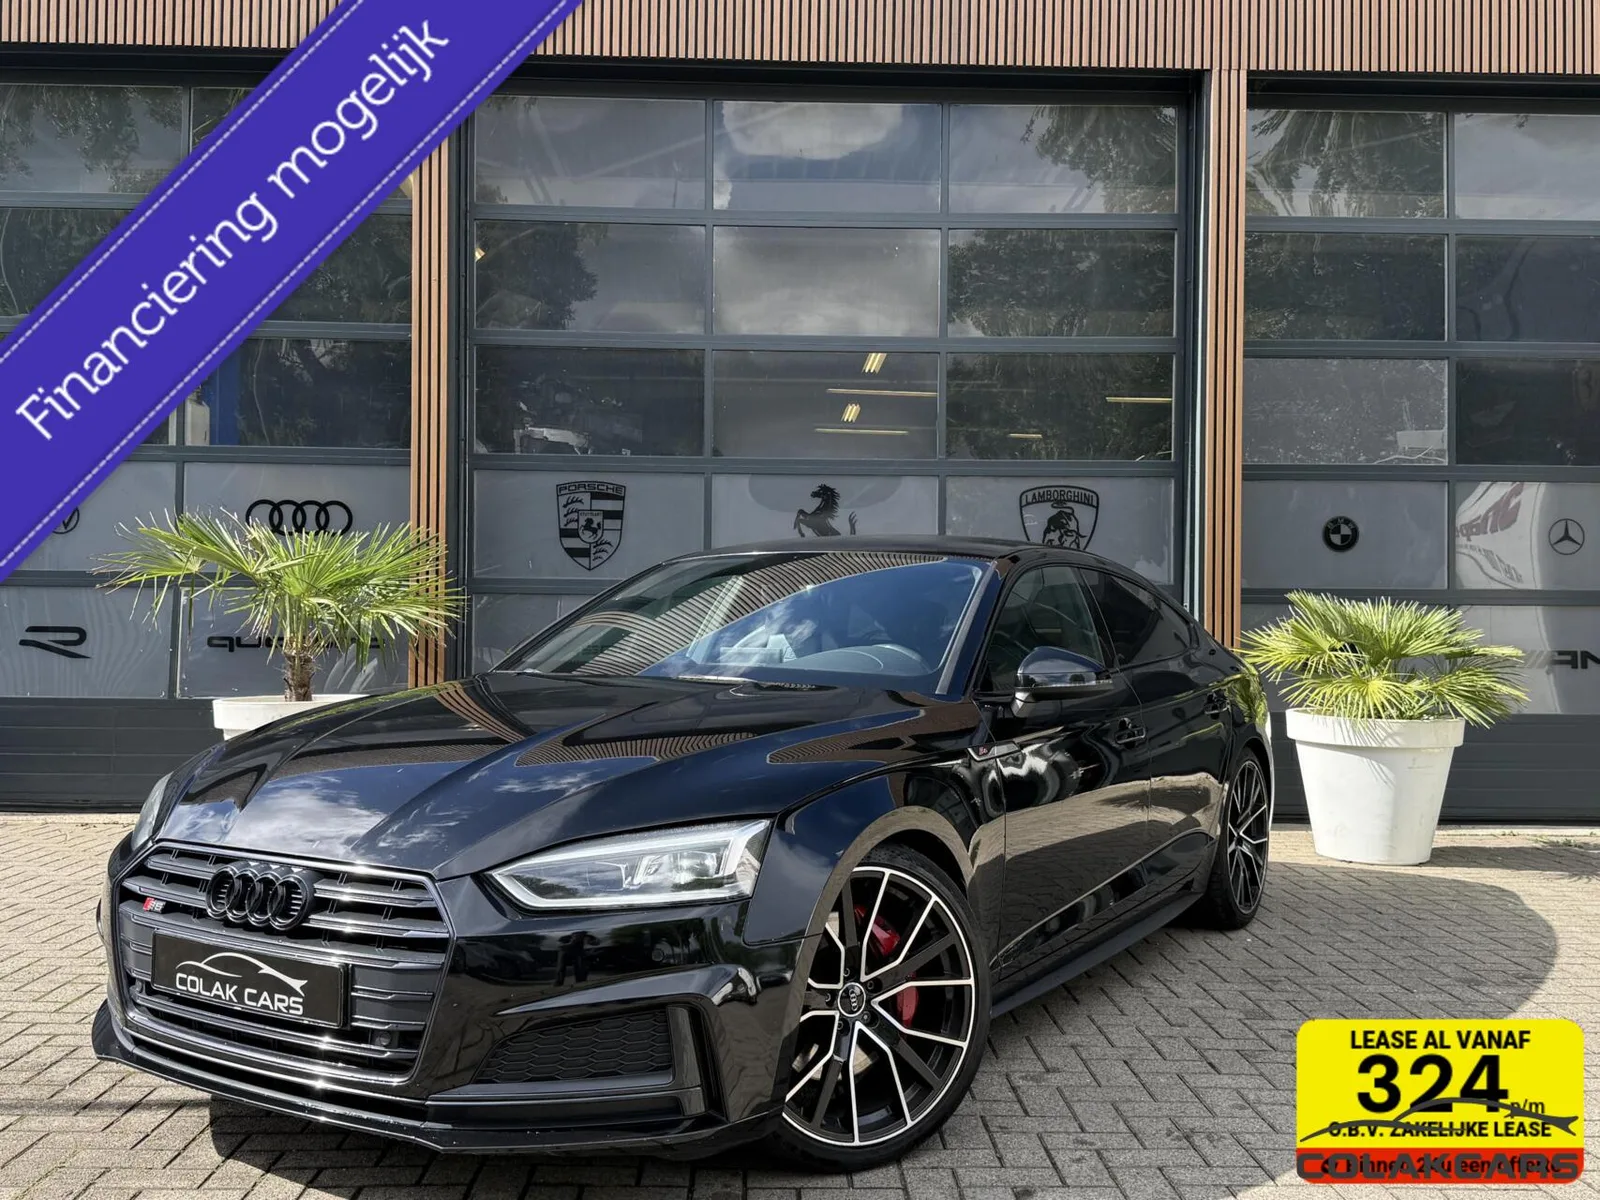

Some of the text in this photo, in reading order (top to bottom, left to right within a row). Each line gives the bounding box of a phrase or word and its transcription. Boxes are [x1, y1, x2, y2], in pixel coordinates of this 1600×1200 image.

[558, 483, 623, 494] PORSCHE
[1025, 489, 1094, 505] LAMBORGHINI
[175, 972, 304, 1016] COLAK CARS
